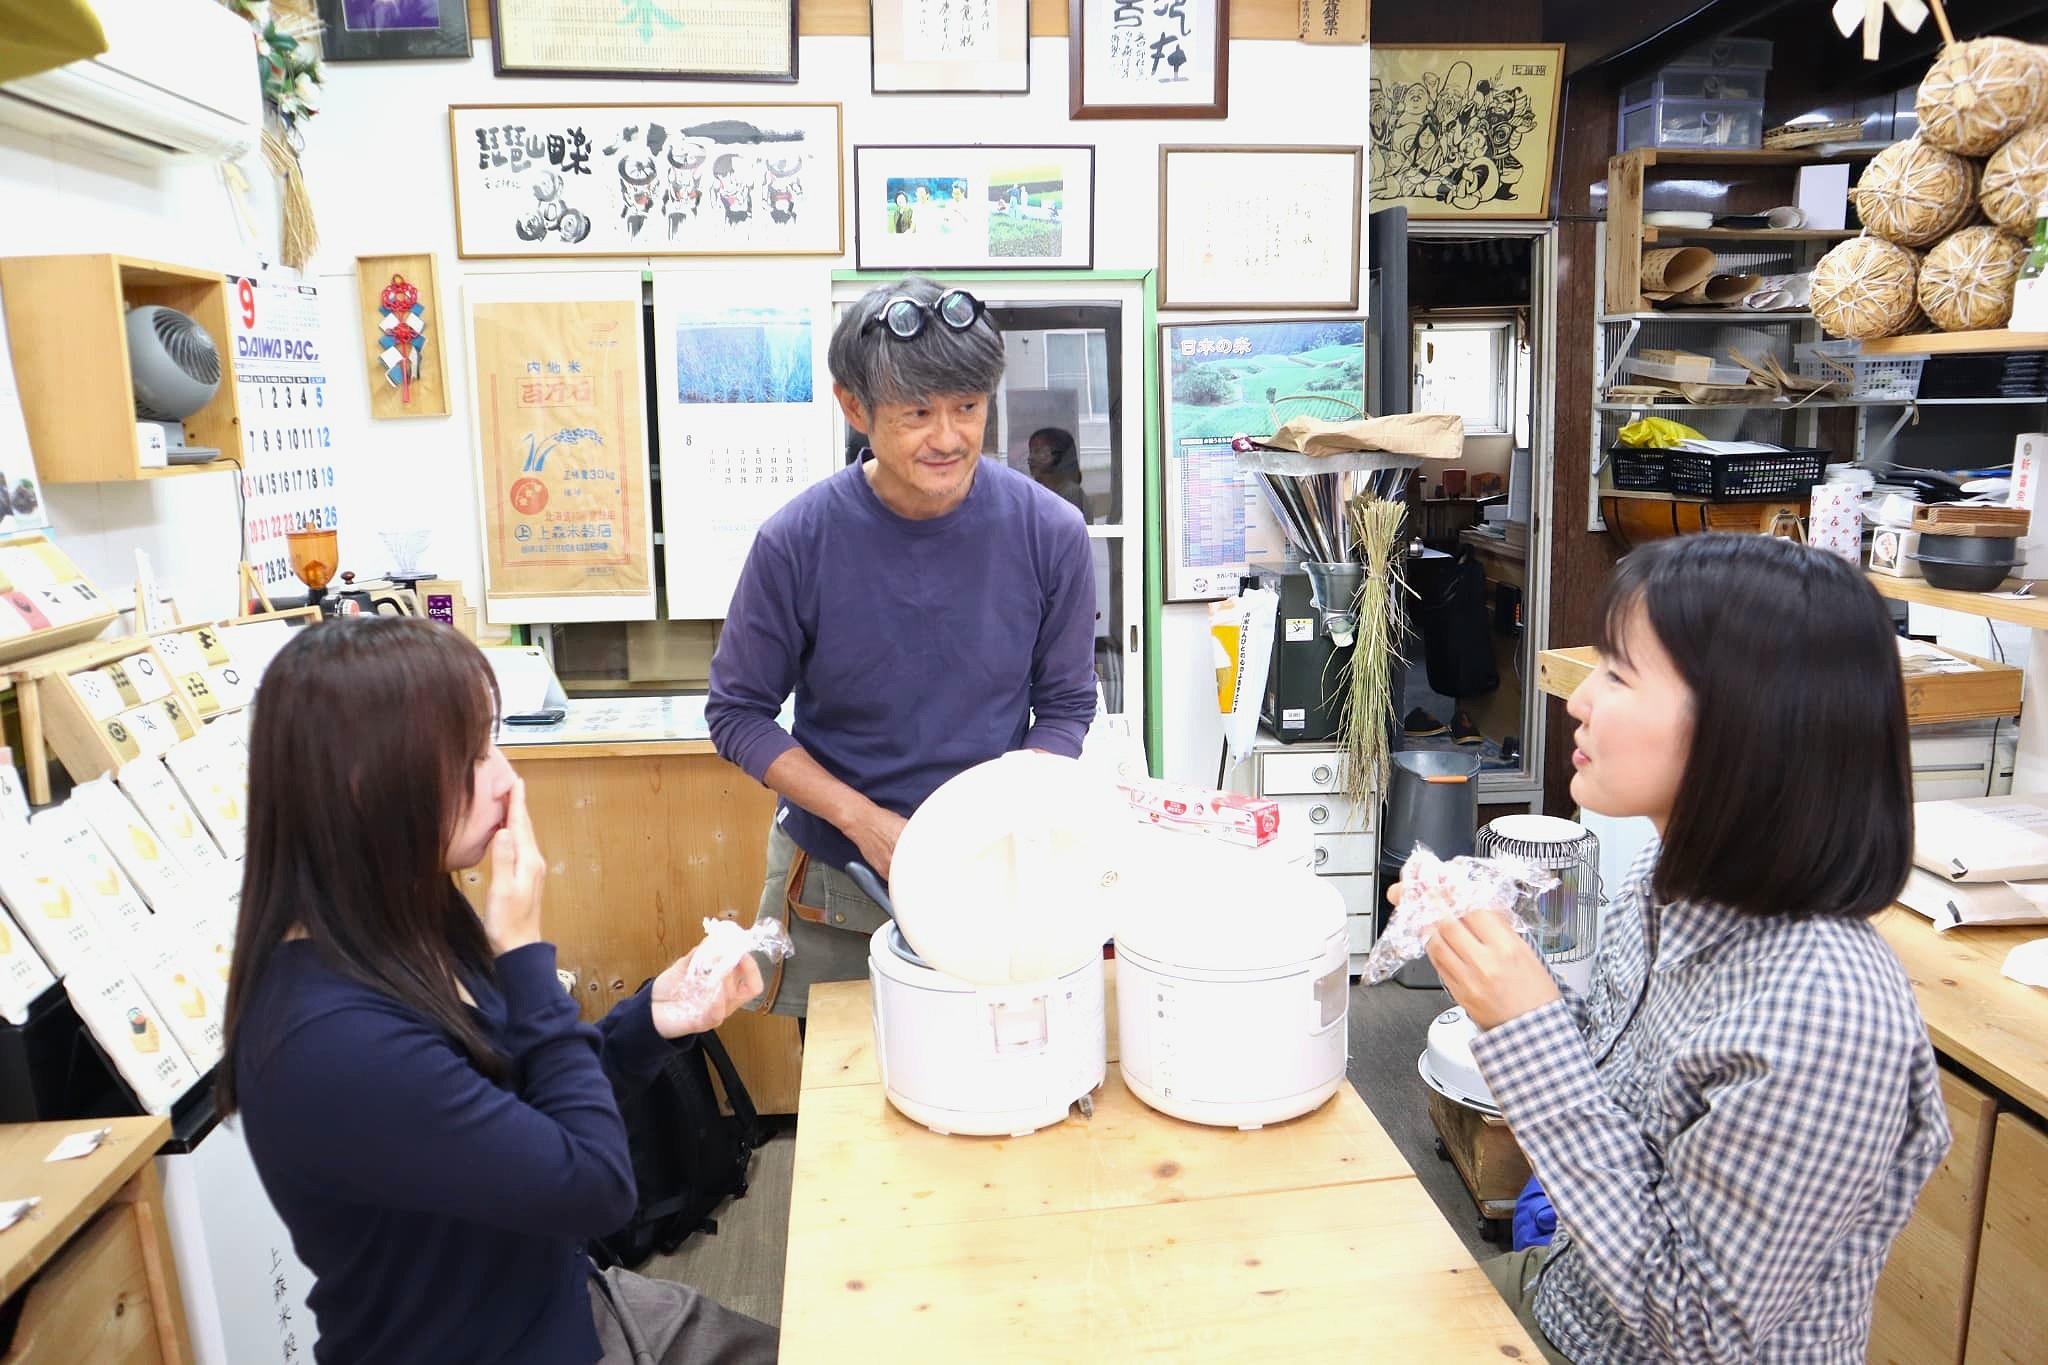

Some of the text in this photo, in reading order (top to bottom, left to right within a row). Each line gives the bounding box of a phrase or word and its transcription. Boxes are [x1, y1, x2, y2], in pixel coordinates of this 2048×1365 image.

[1320, 0, 1342, 36] 録票
[239, 278, 255, 330] 9
[238, 335, 281, 359] DAIWA
[1181, 336, 1253, 356] 日本の米
[527, 359, 582, 374] 内地米
[259, 386, 323, 408] 1 2 3 4 5
[249, 426, 330, 452] 7 8 9 10 11 12
[755, 457, 761, 465] 13
[786, 456, 793, 464] 15
[253, 475, 264, 496] 14
[266, 473, 277, 495] 15
[279, 471, 290, 492] 16
[292, 470, 302, 491] 17
[306, 468, 318, 489] 18
[321, 466, 334, 487] 19
[786, 475, 794, 483] 29
[259, 517, 270, 541] 21
[271, 515, 282, 538] 22
[284, 512, 295, 533] 23
[296, 511, 307, 530] 24
[309, 508, 322, 529] 25
[324, 505, 338, 527] 26
[265, 560, 276, 584] 28
[276, 557, 287, 581] 29
